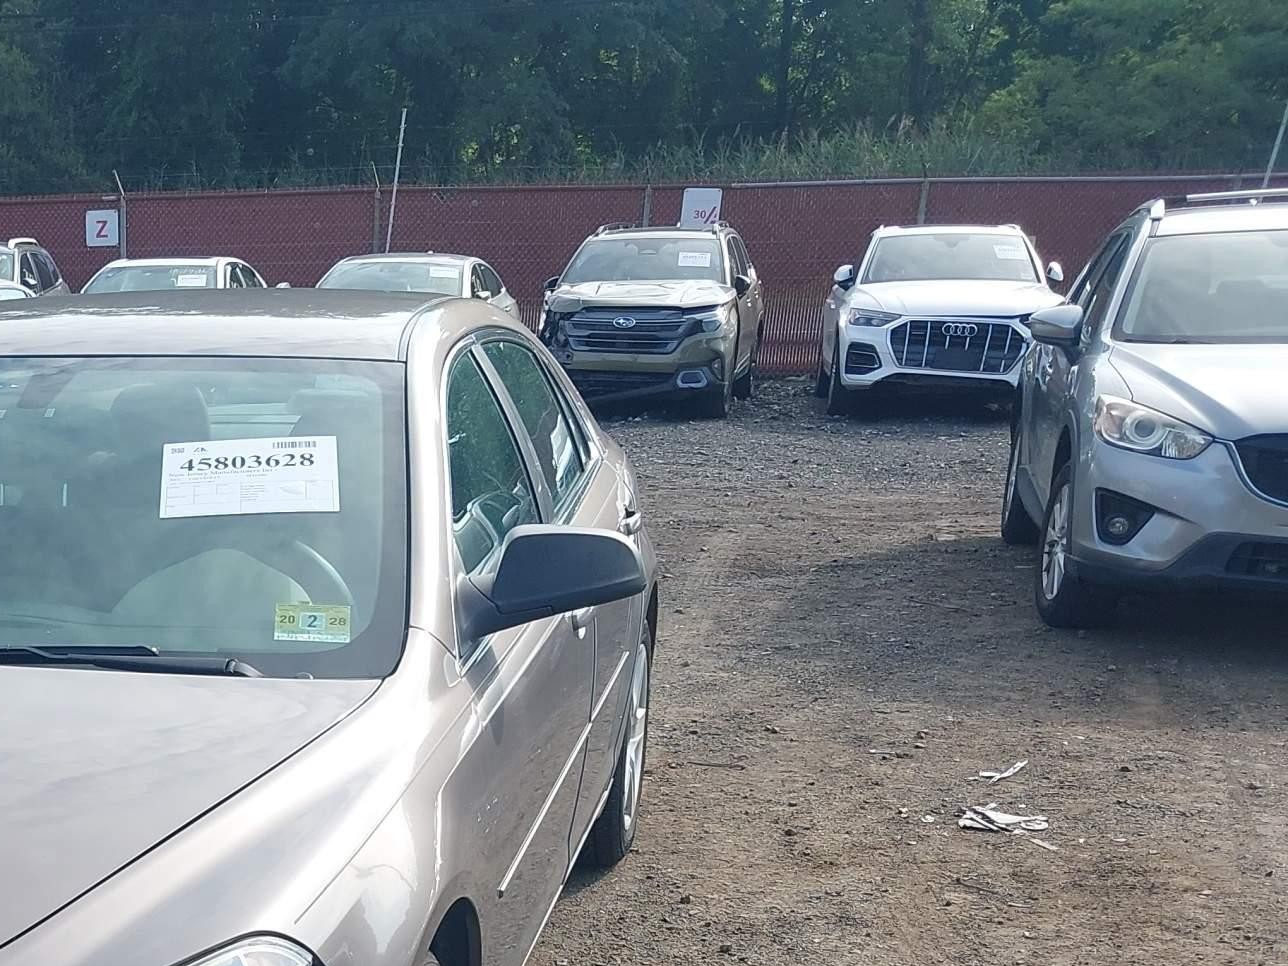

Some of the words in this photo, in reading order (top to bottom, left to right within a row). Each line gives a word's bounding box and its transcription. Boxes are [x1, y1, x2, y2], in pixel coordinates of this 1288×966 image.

[95, 220, 109, 239] Z
[179, 453, 315, 472] 45803628
[279, 614, 296, 624] 20
[307, 614, 318, 628] 2
[328, 617, 347, 626] 28
